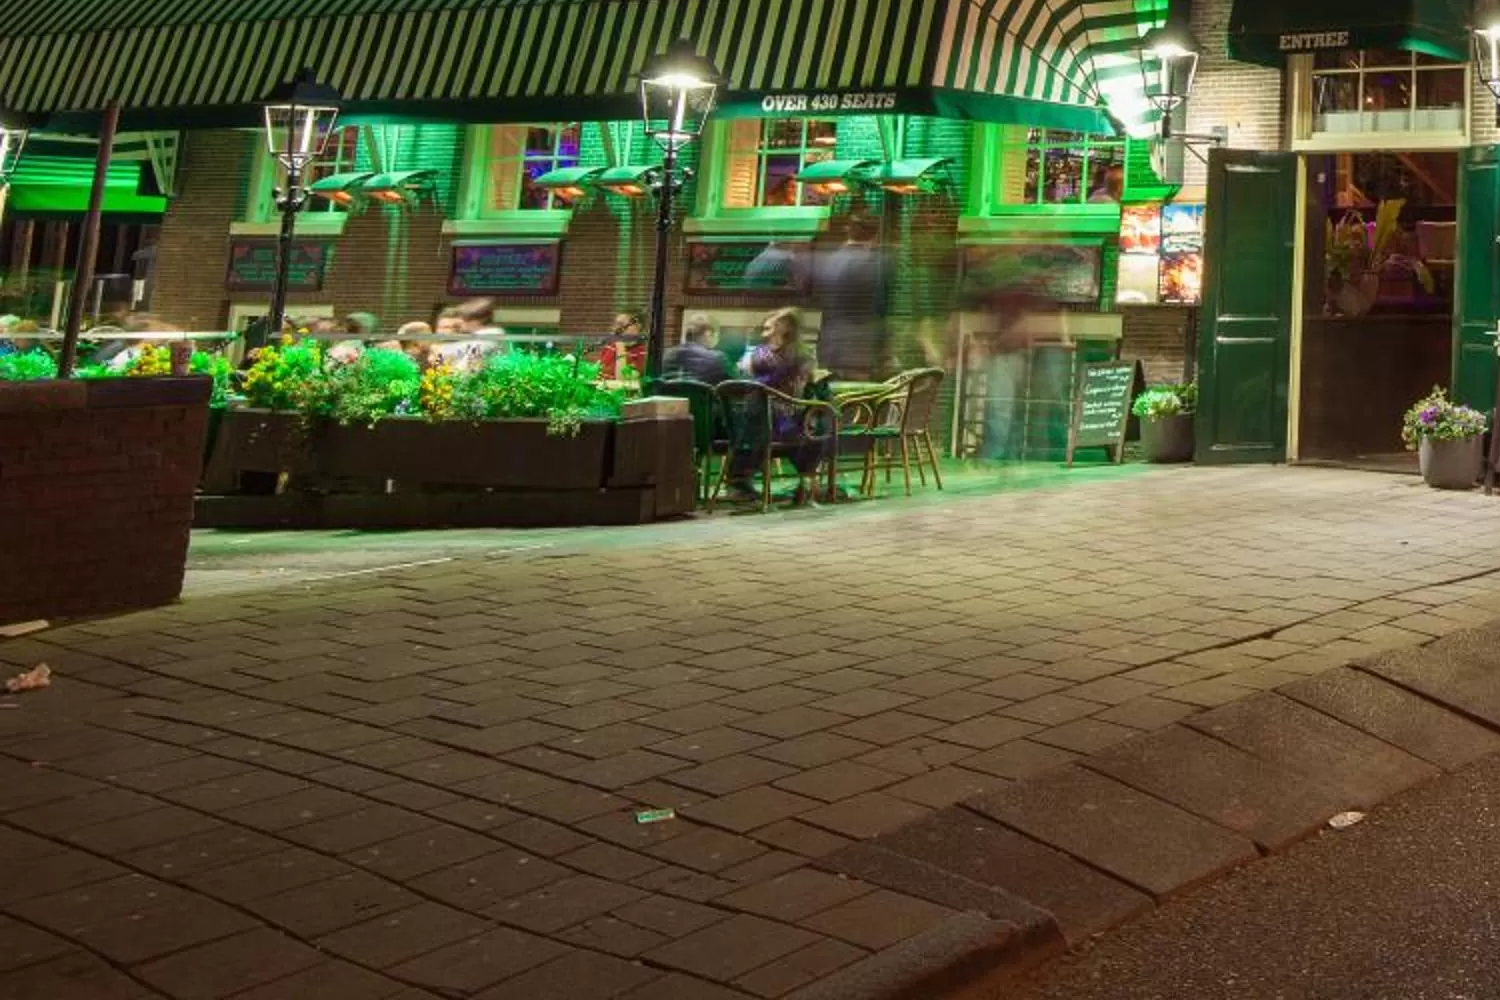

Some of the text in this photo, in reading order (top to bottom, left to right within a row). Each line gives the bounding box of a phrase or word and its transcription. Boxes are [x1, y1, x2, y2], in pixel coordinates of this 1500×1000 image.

[1280, 31, 1349, 49] ENTREE
[761, 93, 896, 112] OVER 430 SEATS
